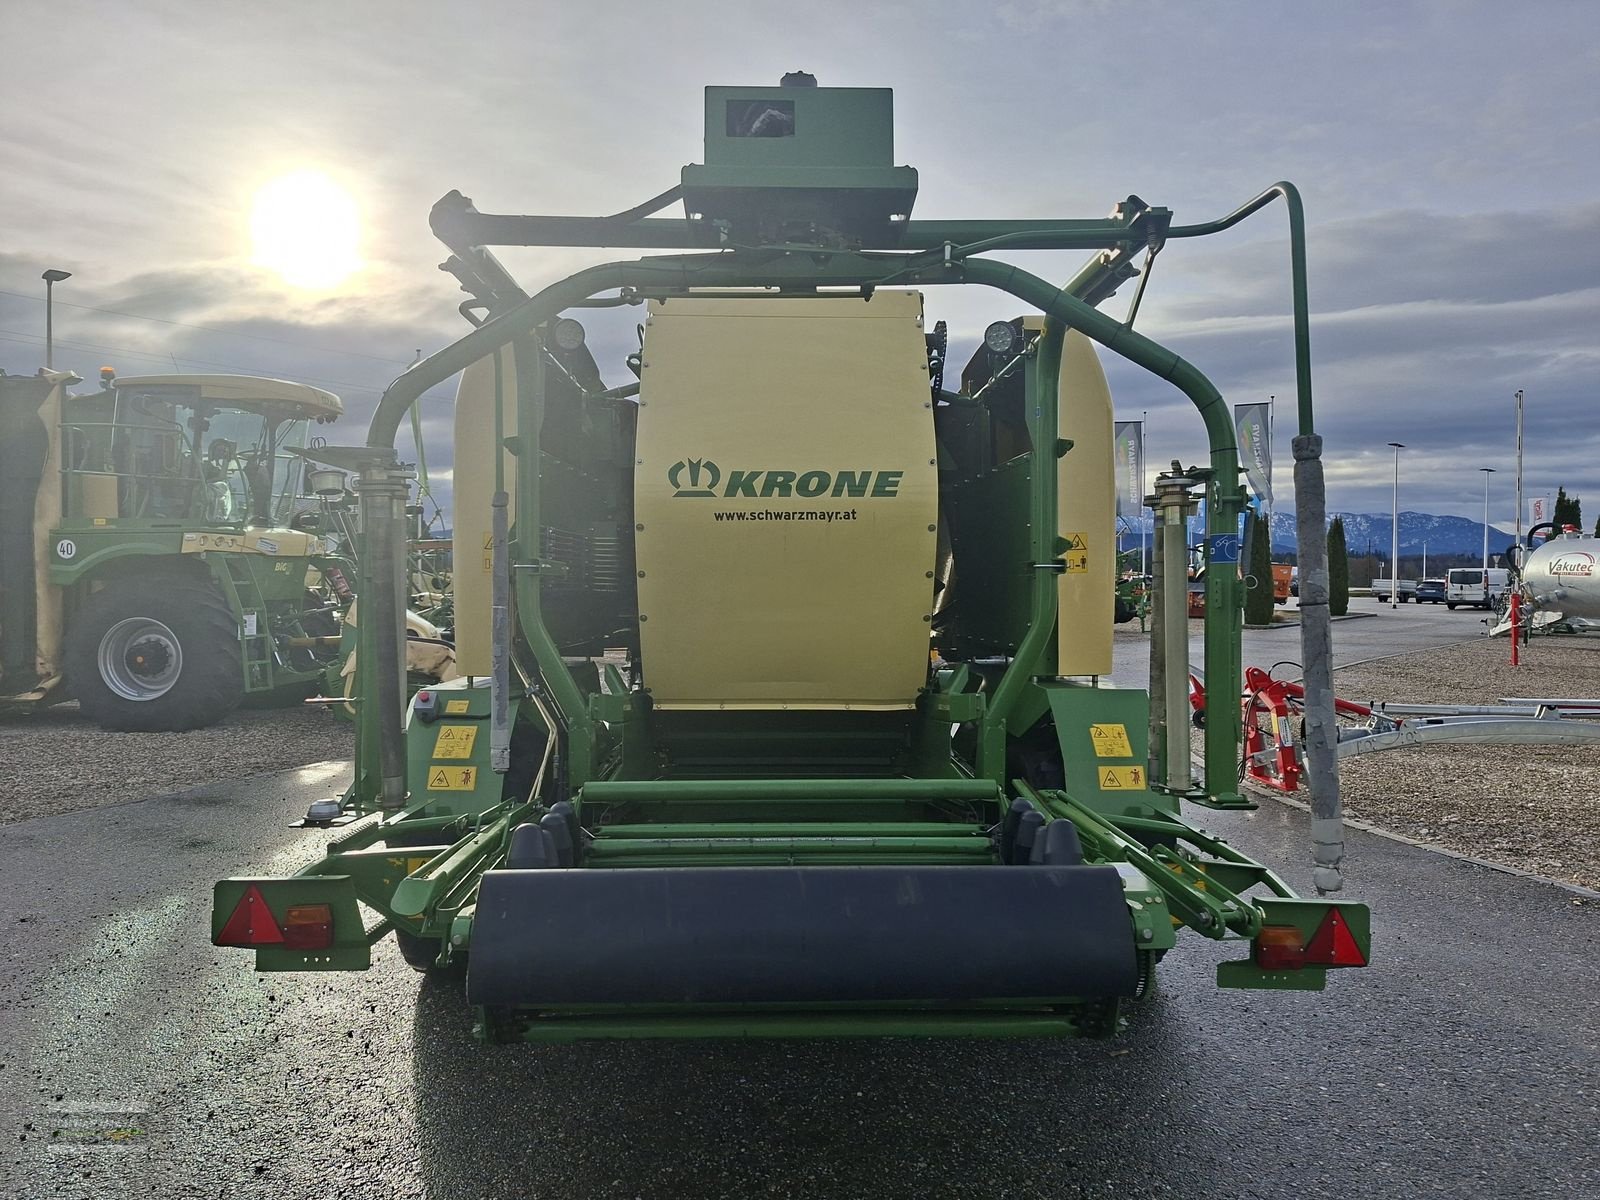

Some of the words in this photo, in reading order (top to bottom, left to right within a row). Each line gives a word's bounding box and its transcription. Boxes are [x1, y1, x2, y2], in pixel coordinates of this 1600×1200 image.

[723, 470, 905, 498] KRONE
[714, 509, 857, 523] www.schwarzmayr.at
[59, 542, 73, 556] 40
[1549, 558, 1594, 575] Vakutec
